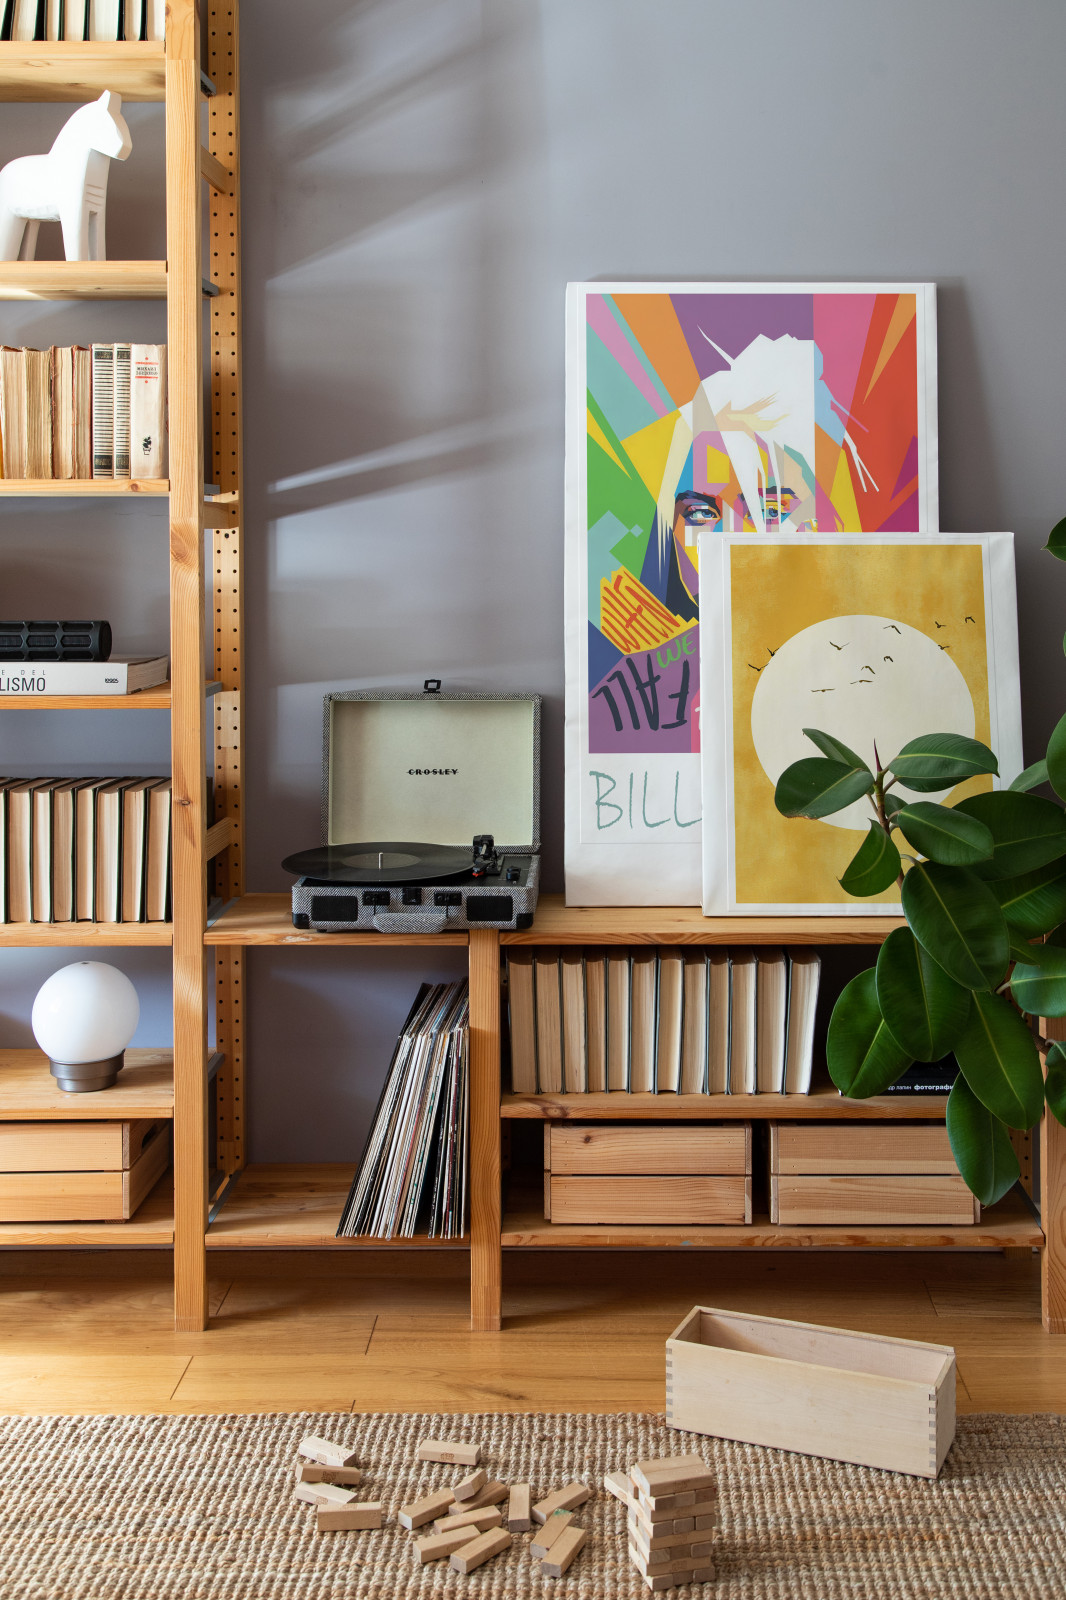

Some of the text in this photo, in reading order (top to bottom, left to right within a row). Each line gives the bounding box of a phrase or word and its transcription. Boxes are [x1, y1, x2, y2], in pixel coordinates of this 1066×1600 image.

[601, 570, 681, 654] WHEN
[656, 631, 697, 668] WE
[0, 677, 46, 692] LISMO
[591, 653, 690, 732] FALL
[407, 768, 460, 776] CROSLEY
[588, 770, 703, 831] BILL
